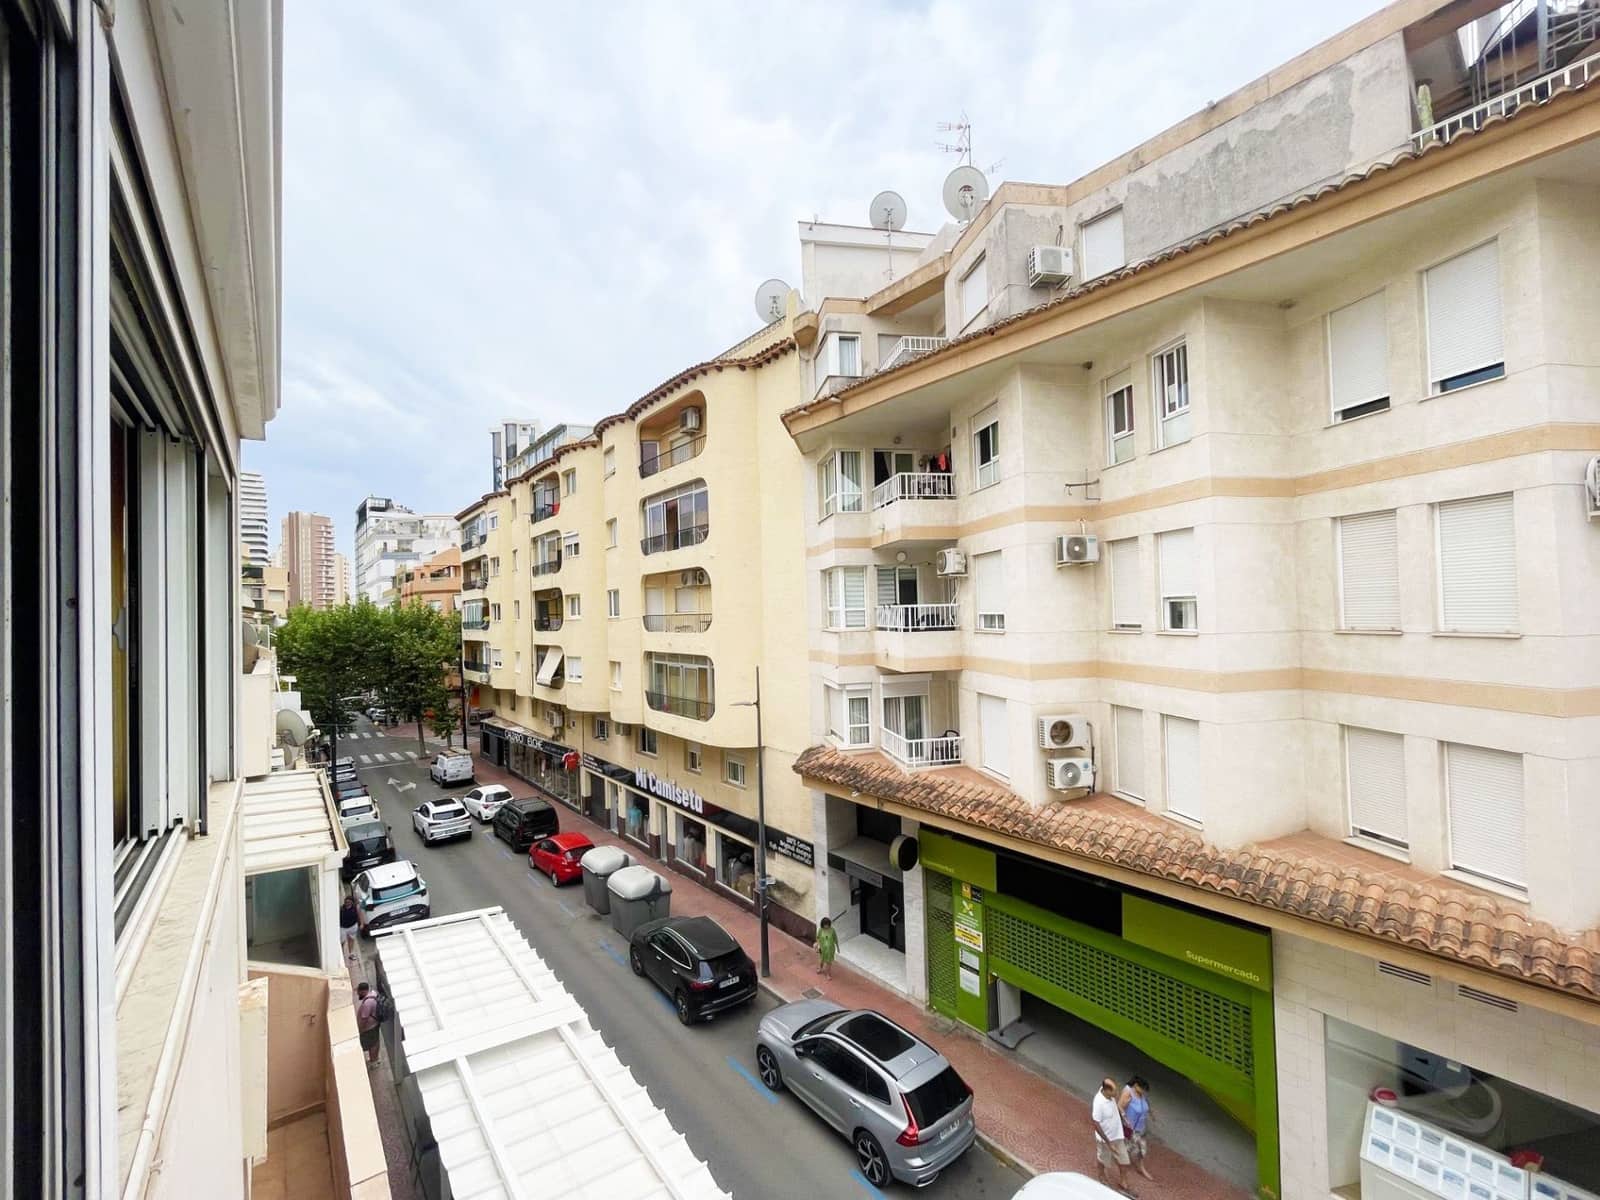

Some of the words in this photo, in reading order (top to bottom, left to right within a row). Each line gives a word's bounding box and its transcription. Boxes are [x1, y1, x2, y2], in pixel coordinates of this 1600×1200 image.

[635, 767, 647, 789] Mi
[648, 772, 704, 814] Camiseta
[1185, 949, 1260, 983] Supermercado
